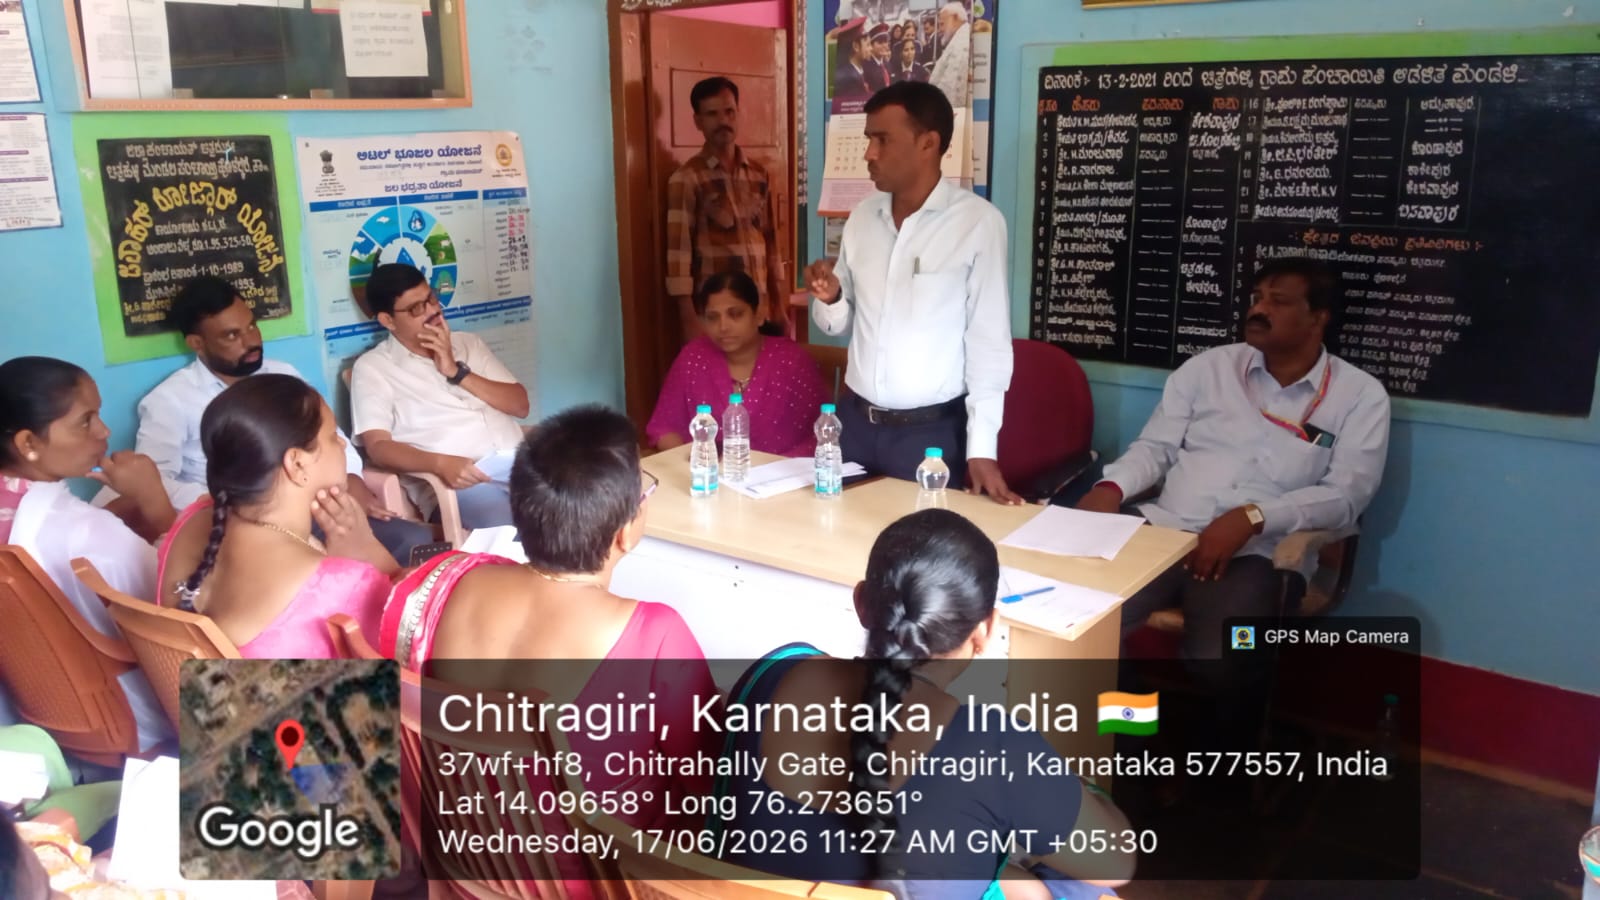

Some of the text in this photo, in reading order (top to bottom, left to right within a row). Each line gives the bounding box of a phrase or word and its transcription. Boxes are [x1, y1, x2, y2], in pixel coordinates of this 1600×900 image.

[1259, 65, 1297, 90] ಗ್ರಾಮ
[357, 144, 482, 162] ಅಟಲ್ ಭೂಜಲ ಯೋಜನೆ
[384, 183, 399, 193] ಜಲ
[429, 178, 463, 190] ಯೋಜನೆ
